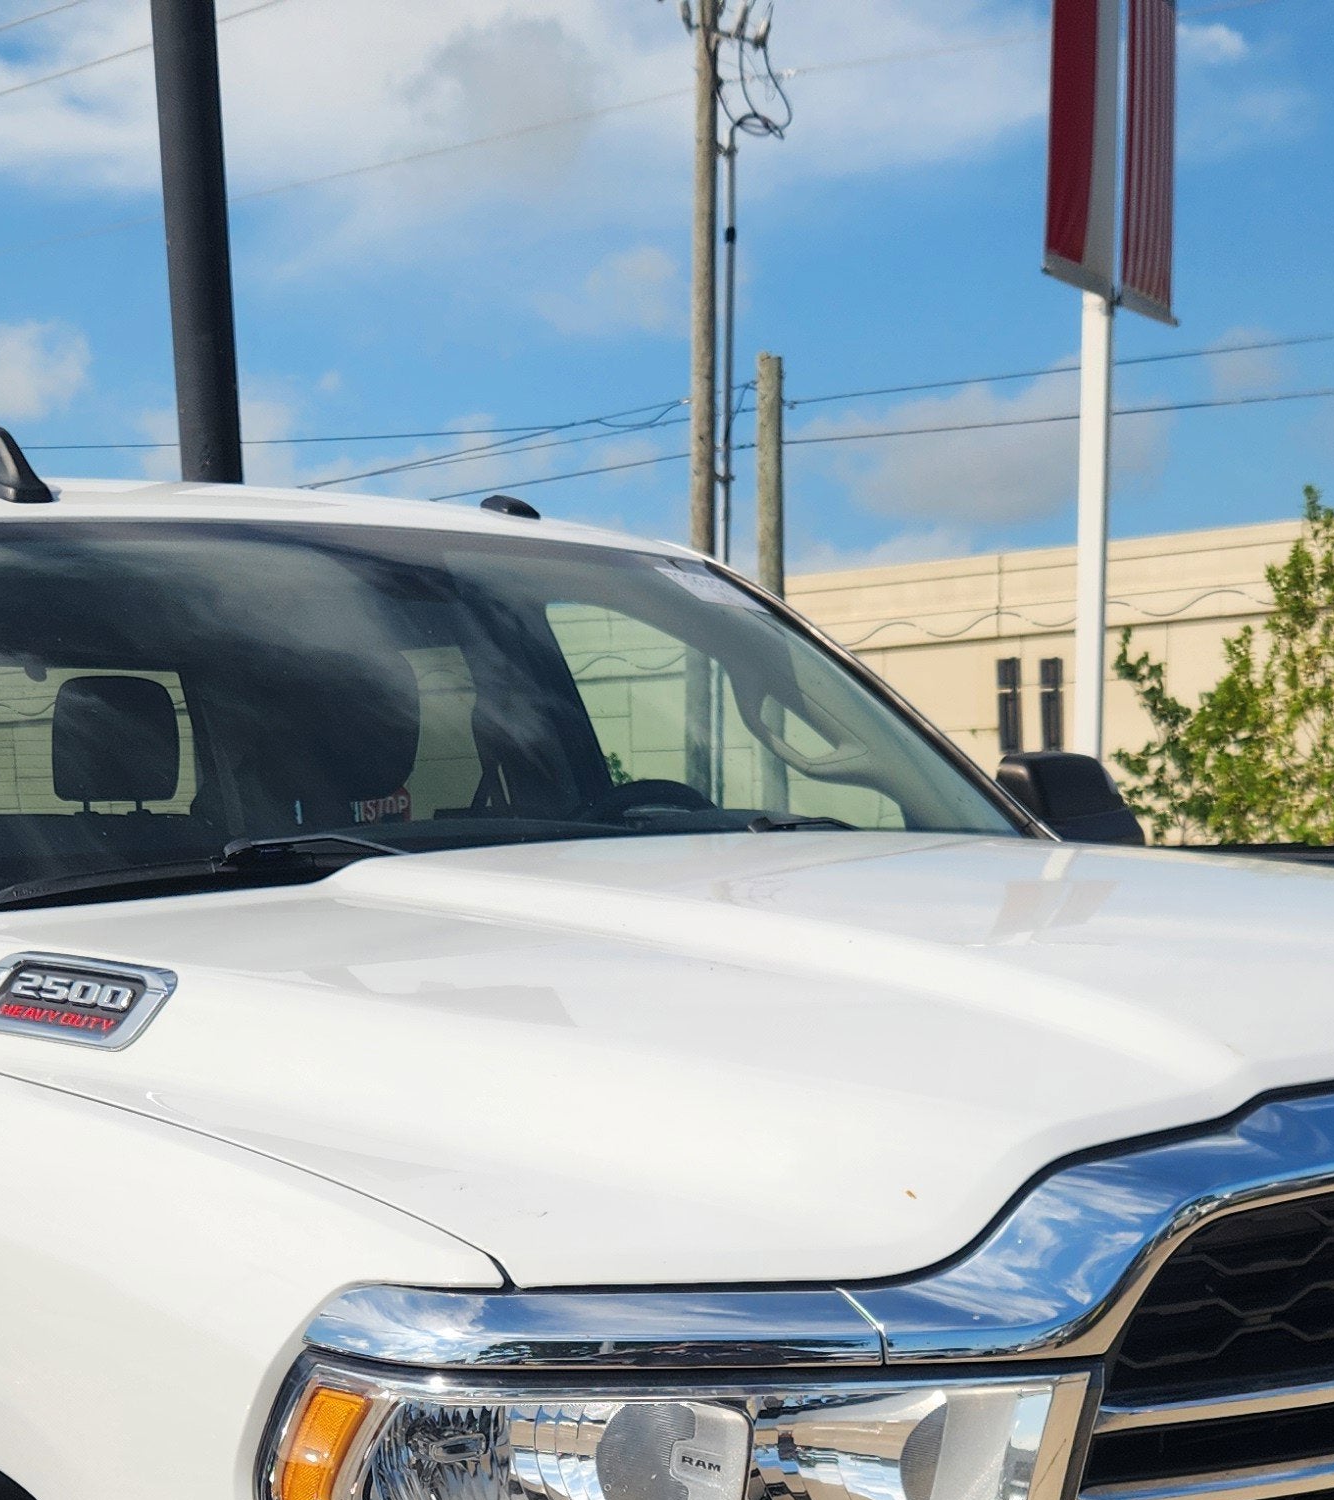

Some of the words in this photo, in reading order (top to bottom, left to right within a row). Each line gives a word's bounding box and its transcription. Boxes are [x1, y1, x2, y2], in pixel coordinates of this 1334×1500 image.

[10, 972, 135, 1012] 2500
[60, 1012, 118, 1033] DUTY
[681, 1455, 721, 1473] RAM
